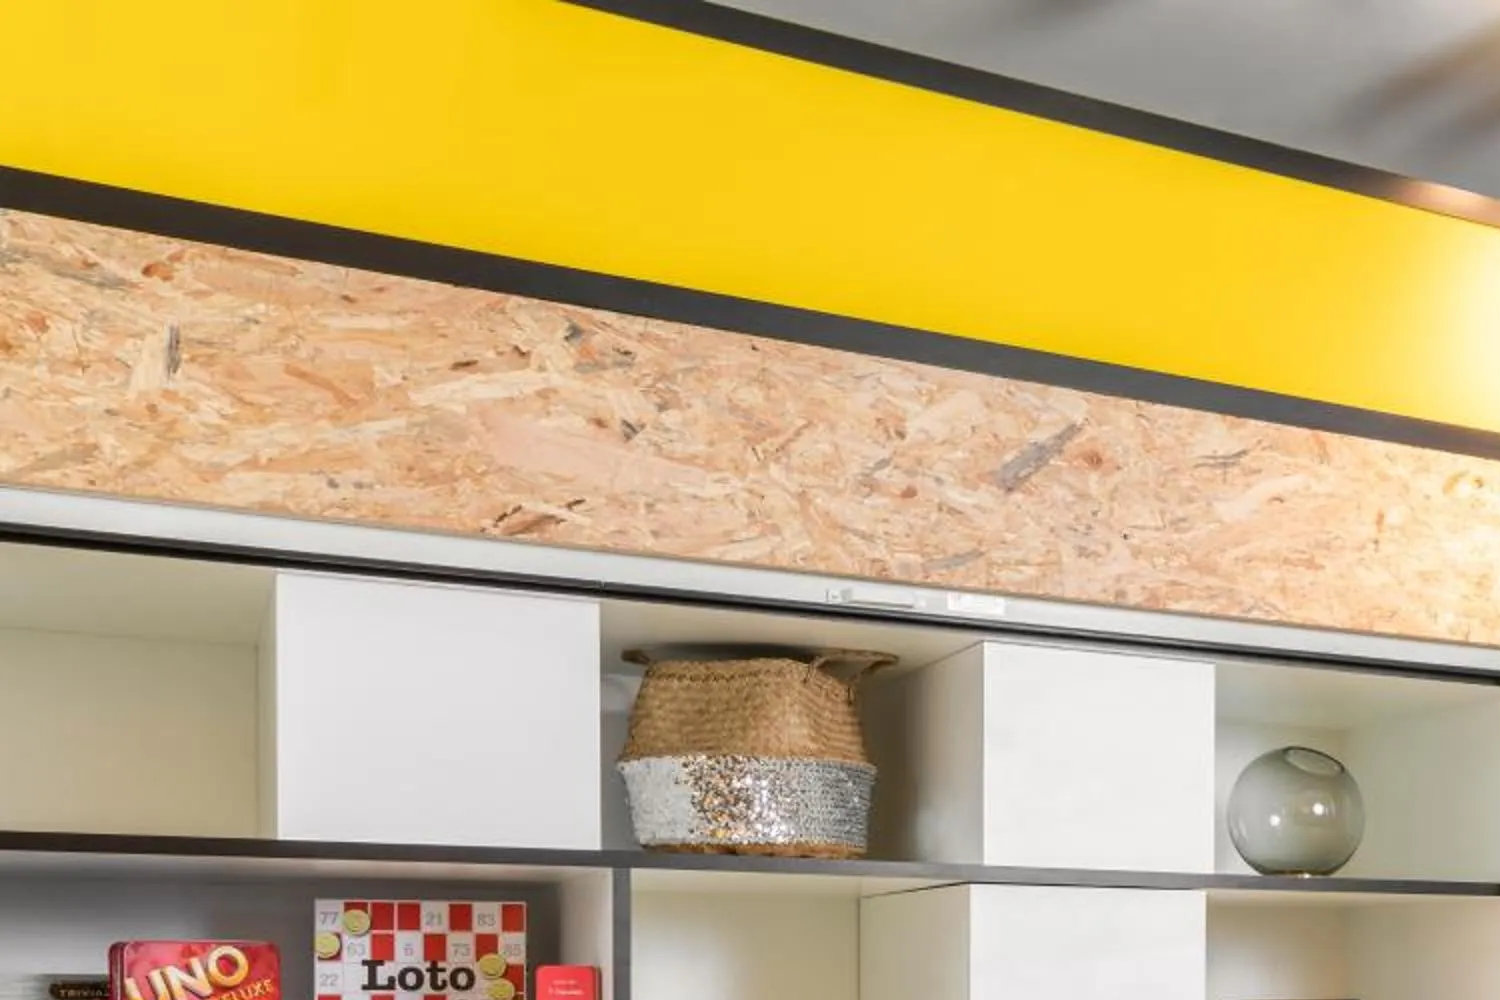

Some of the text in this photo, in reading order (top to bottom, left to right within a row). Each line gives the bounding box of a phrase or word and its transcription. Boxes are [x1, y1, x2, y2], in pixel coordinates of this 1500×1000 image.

[320, 911, 338, 924] 77
[320, 973, 338, 987] 22
[361, 959, 475, 991] Loto
